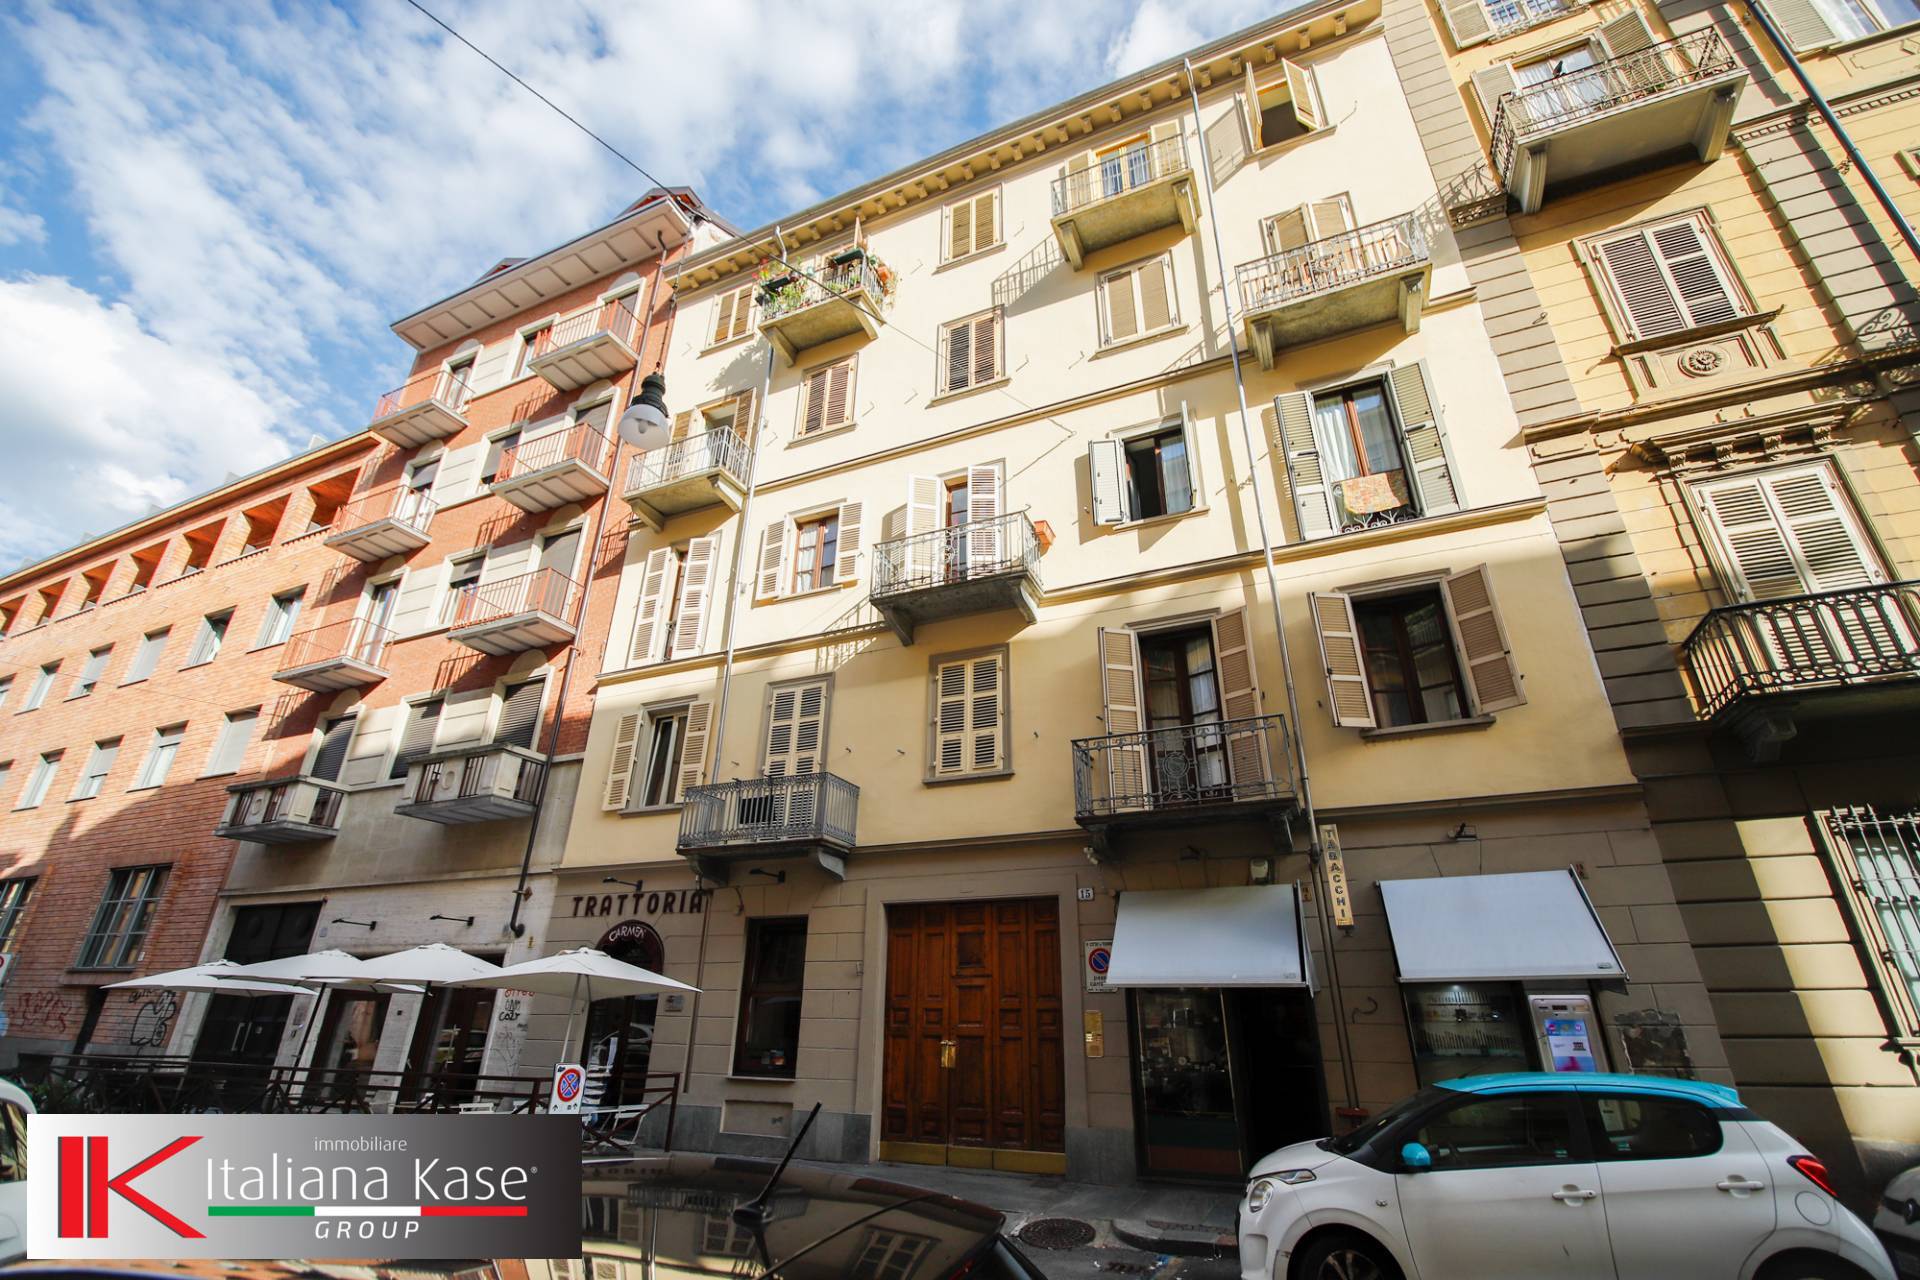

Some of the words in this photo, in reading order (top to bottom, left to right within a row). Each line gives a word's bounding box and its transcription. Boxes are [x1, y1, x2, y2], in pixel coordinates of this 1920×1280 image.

[1326, 830, 1346, 918] TABACCHI
[573, 889, 702, 917] TRATTORIA
[1080, 889, 1091, 899] 15
[608, 926, 646, 942] CARMEN
